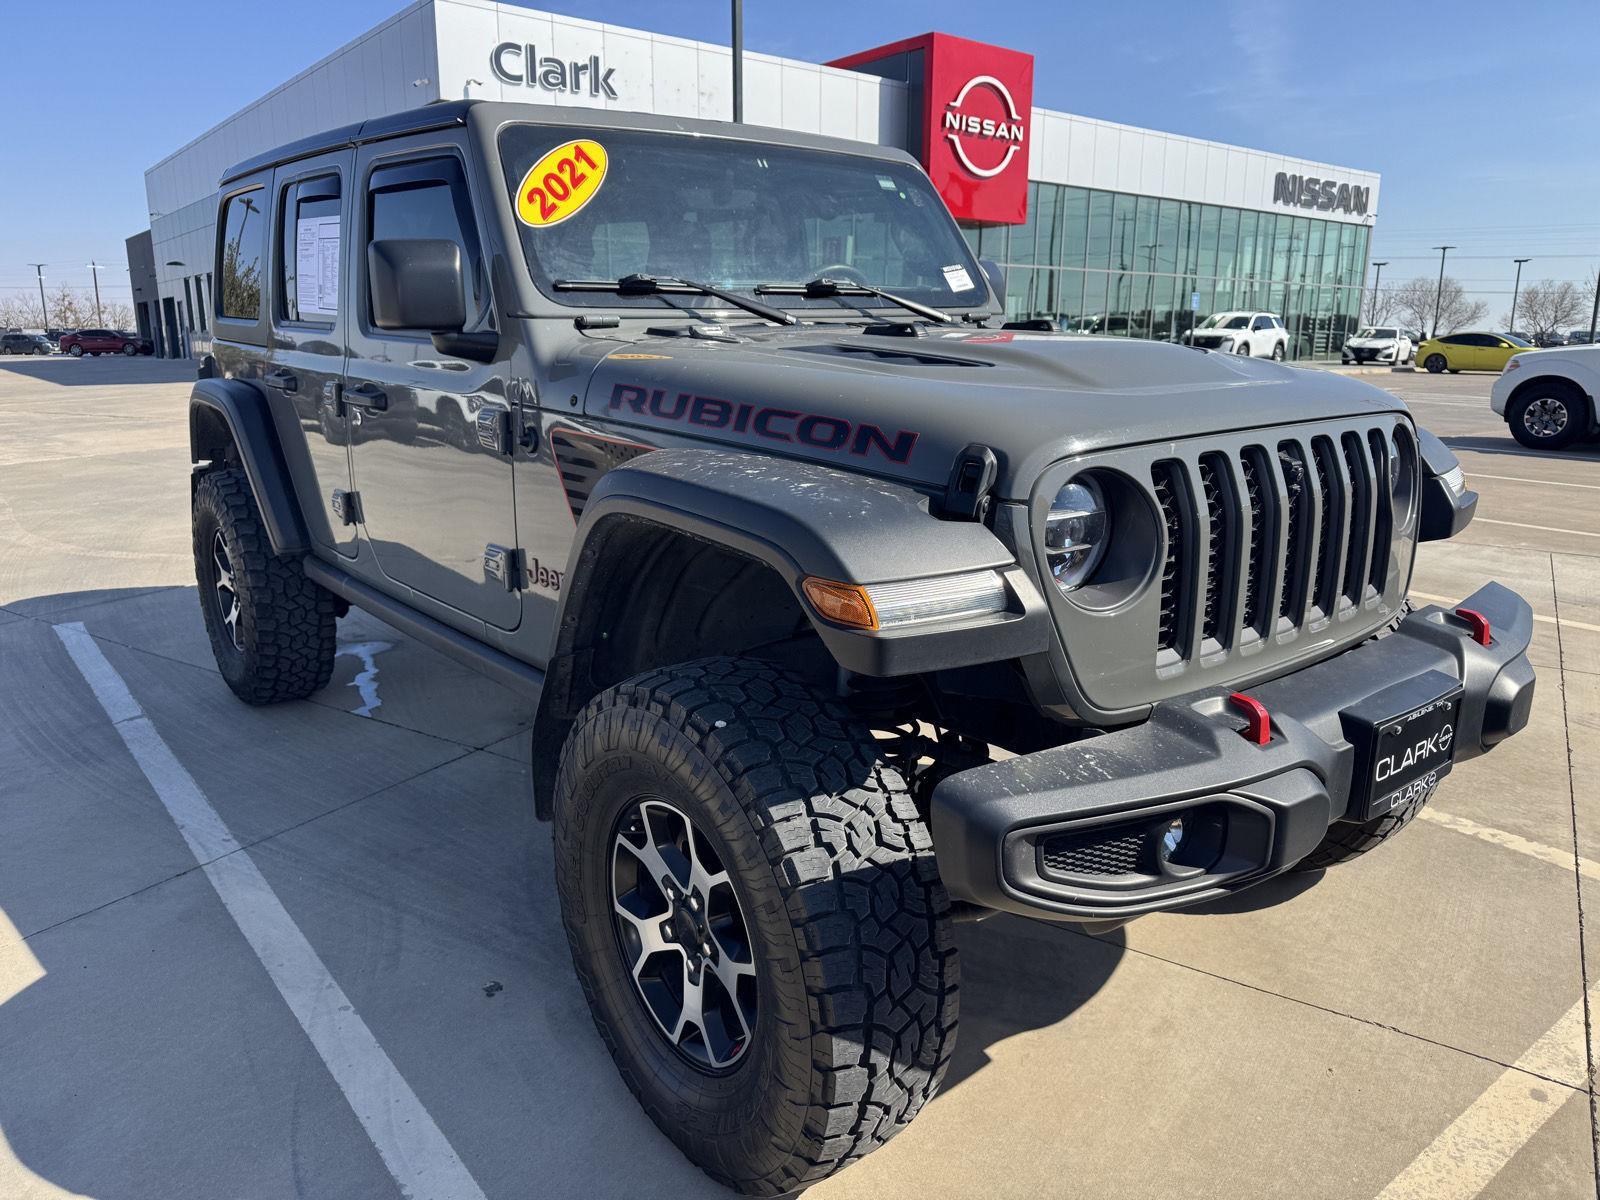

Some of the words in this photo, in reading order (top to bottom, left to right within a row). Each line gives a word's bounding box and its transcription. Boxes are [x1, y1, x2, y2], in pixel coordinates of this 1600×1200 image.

[490, 42, 618, 99] Clark
[945, 111, 1024, 142] NISSAN
[527, 145, 599, 221] 2021
[1273, 172, 1370, 216] NISSAN
[609, 383, 920, 464] RUBICON
[1376, 732, 1438, 782] CLARK
[1391, 775, 1430, 808] CLARK
